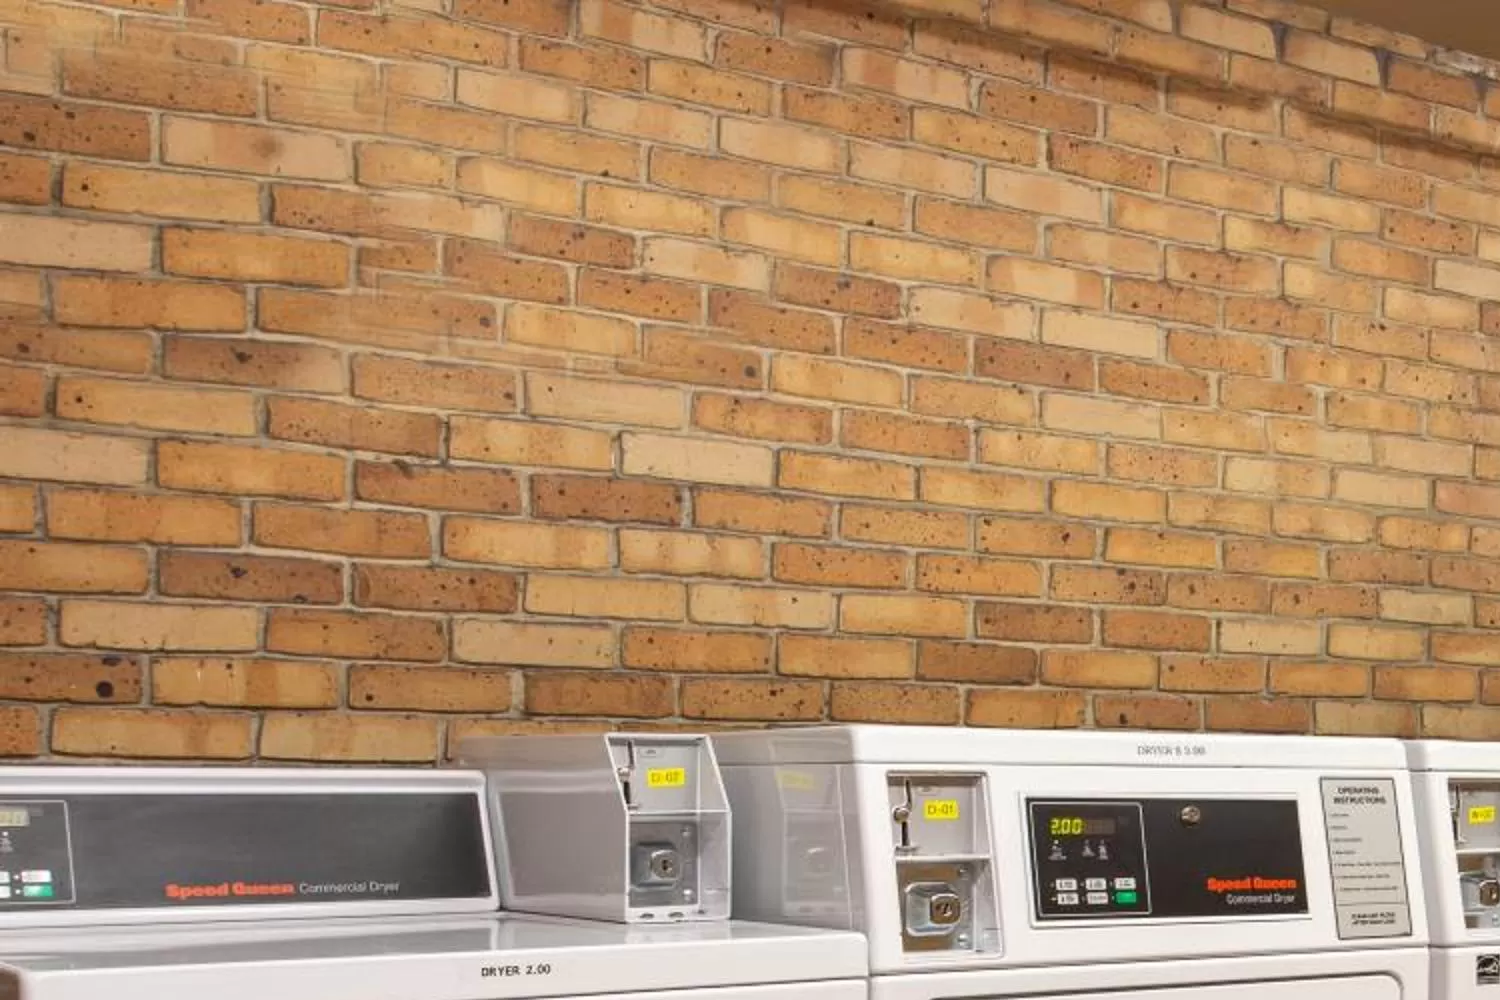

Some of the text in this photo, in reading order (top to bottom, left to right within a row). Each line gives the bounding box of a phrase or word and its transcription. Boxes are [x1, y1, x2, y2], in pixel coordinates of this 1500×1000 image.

[165, 880, 400, 900] Speed Queen Commercial Dryer
[481, 963, 552, 977] DRYER 2.00
